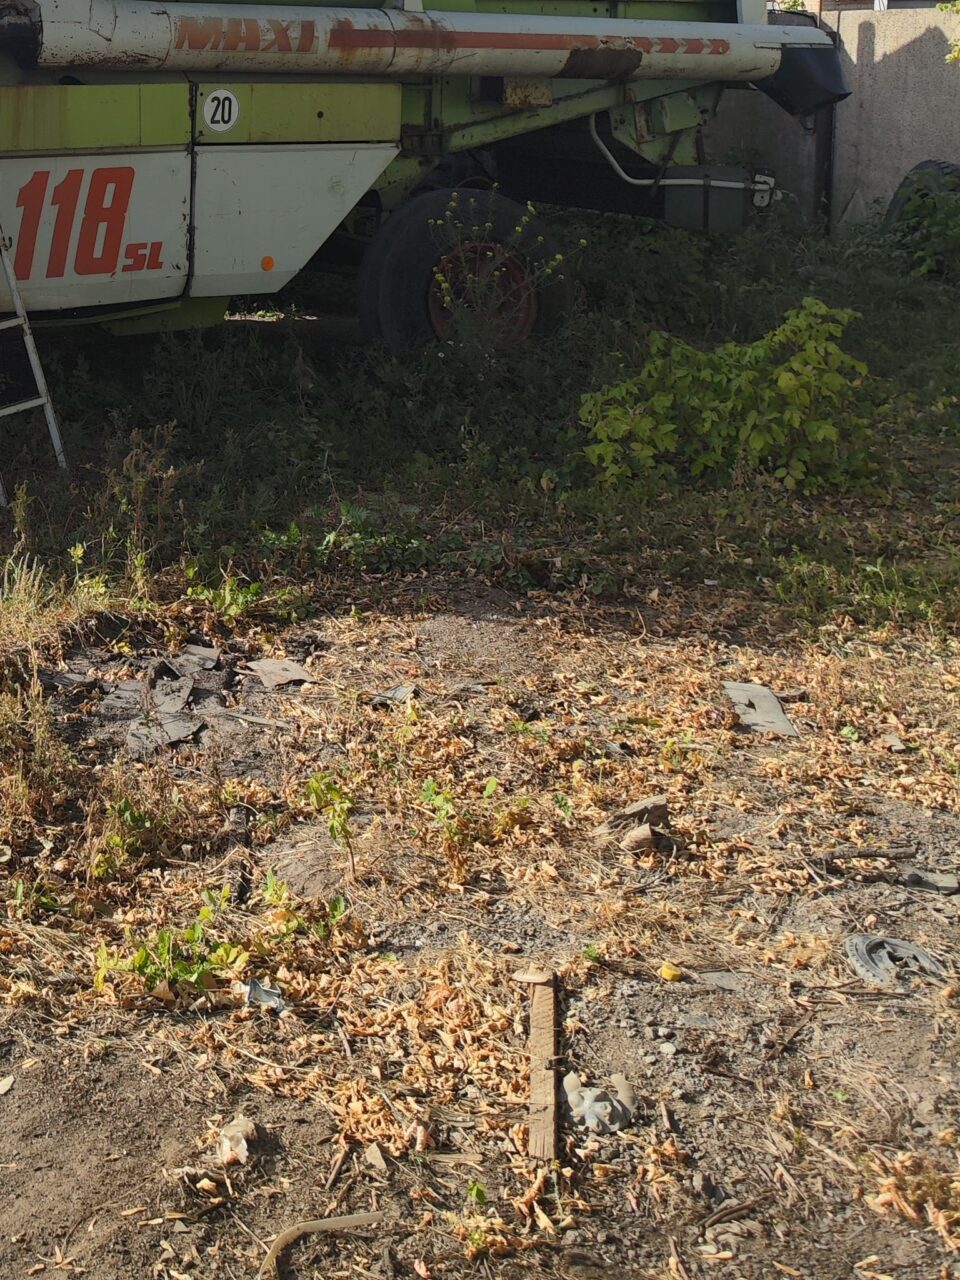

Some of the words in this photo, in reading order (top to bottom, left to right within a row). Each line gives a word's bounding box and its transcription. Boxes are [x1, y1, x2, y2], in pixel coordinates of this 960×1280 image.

[174, 16, 316, 53] MAXI
[210, 96, 232, 125] 20
[13, 167, 135, 281] 118
[122, 241, 164, 272] SL
